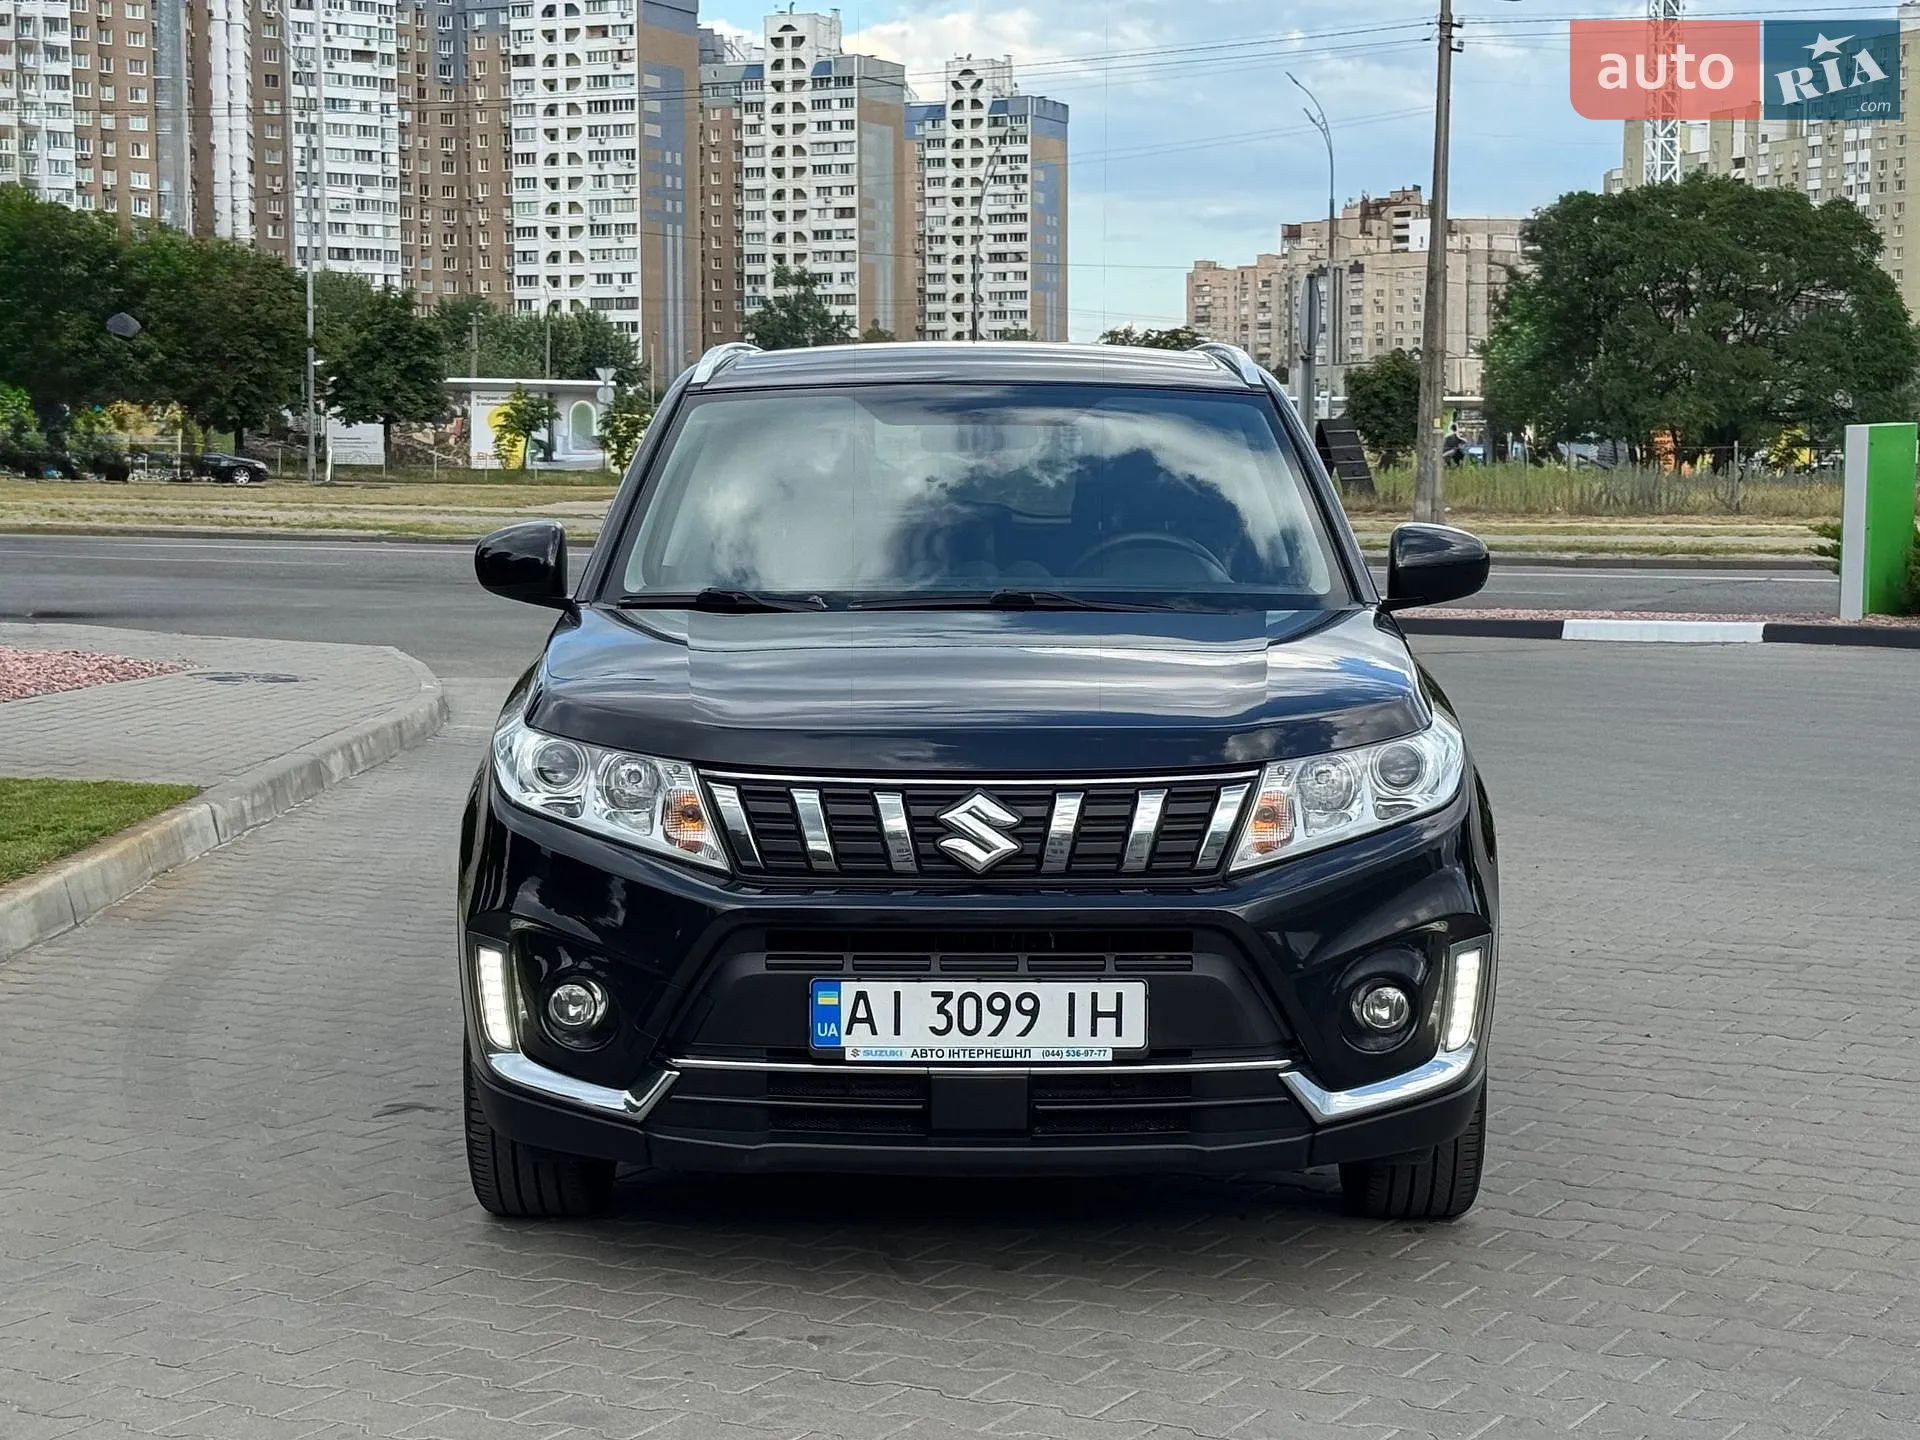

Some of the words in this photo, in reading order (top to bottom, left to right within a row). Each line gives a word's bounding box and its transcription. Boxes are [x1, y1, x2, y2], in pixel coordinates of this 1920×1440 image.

[845, 990, 901, 1036] AI
[928, 991, 1041, 1037] 3099
[1067, 991, 1124, 1037] IH
[817, 1022, 839, 1038] UA
[863, 1049, 903, 1057] SUZUKI
[911, 1048, 945, 1059] АВТО
[948, 1048, 1032, 1059] ІНТЕРНЕШНЛ
[1041, 1049, 1064, 1059] (044)
[1065, 1049, 1107, 1058] 536-97-77
